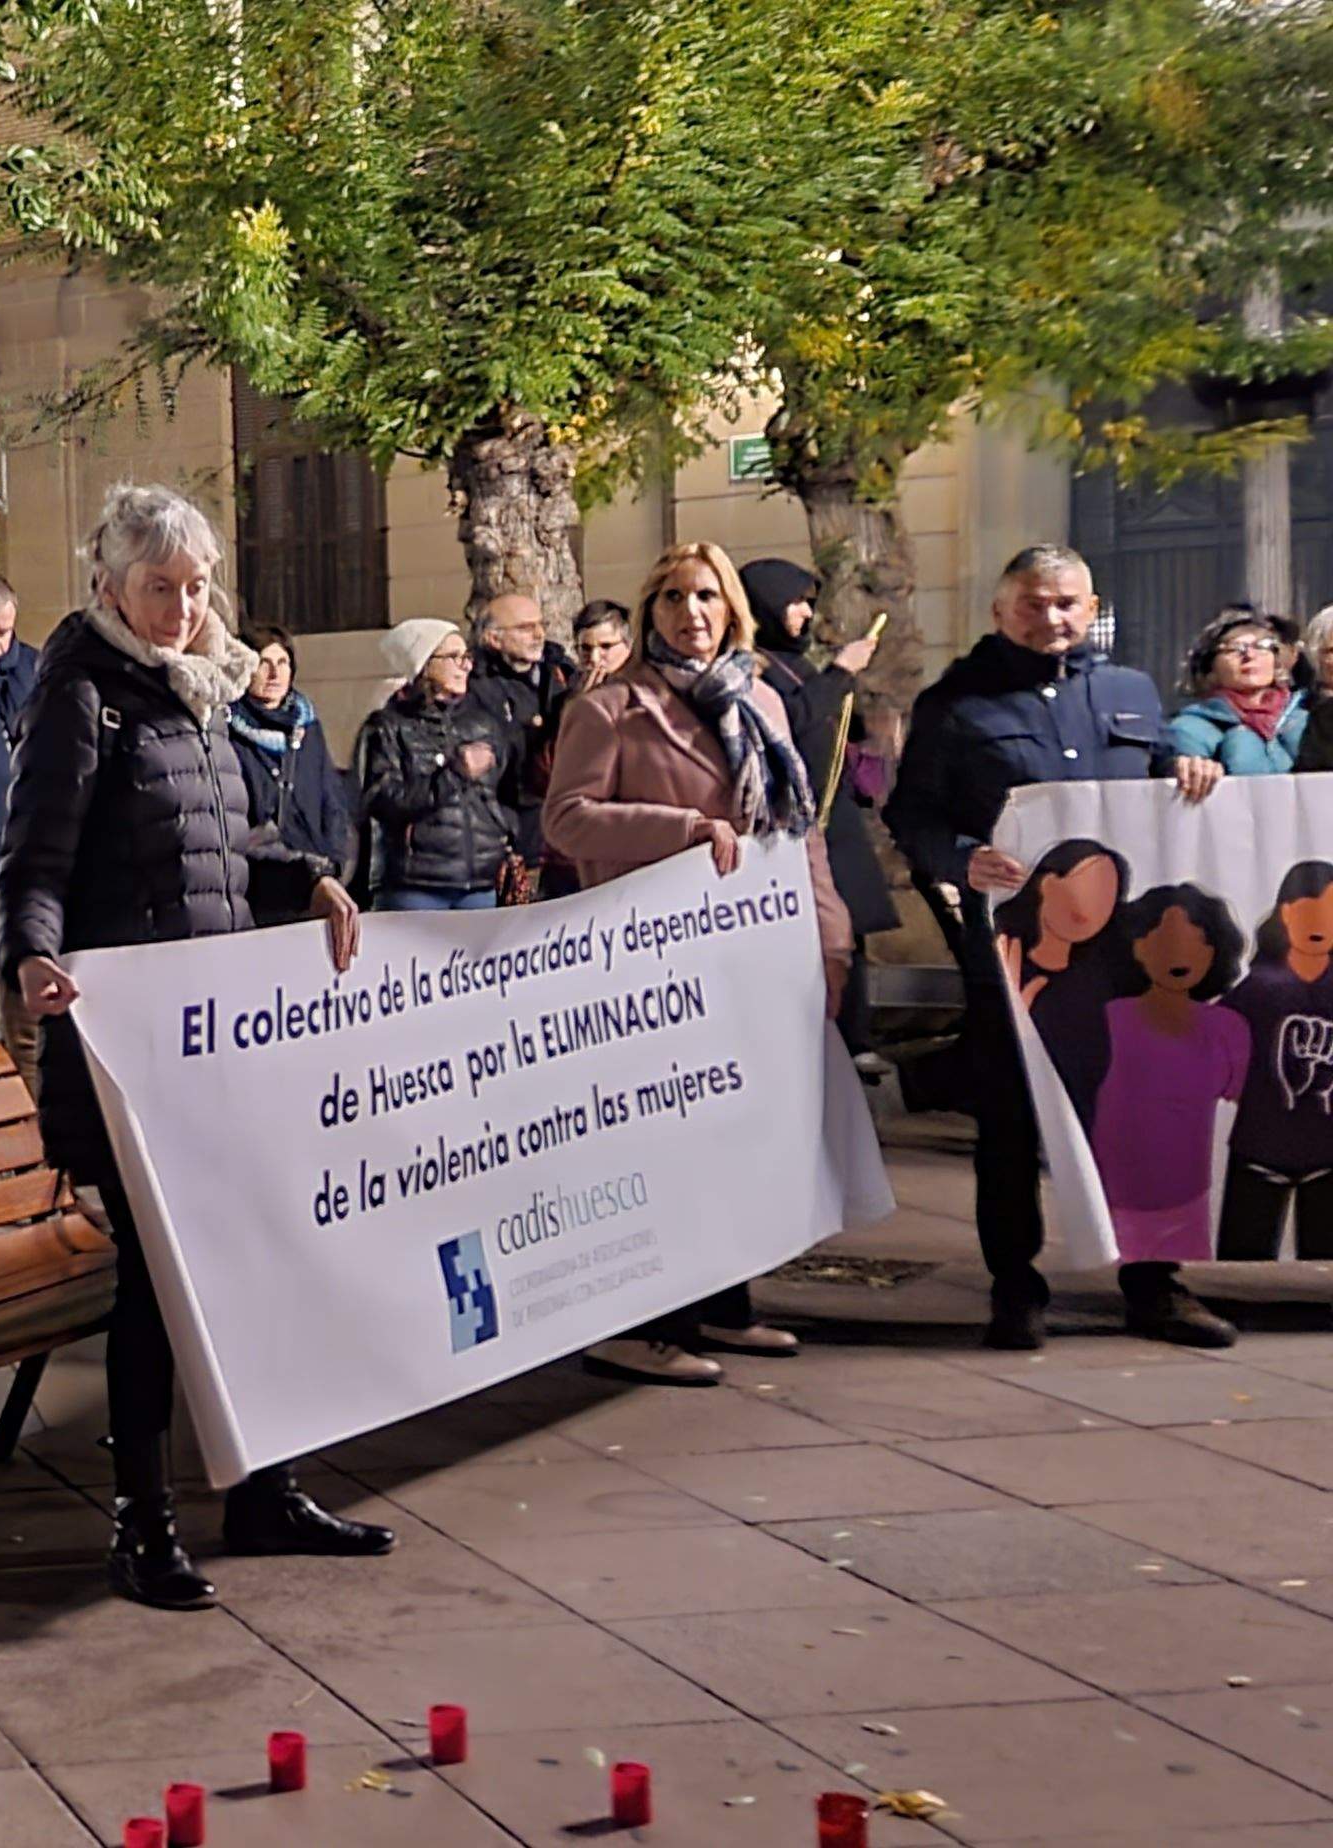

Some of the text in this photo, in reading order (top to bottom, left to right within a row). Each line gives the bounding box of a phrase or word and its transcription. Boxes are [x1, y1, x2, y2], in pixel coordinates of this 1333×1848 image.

[182, 879, 799, 1057] El colectivo de la discapacidad y dependencia
[320, 968, 706, 1128] de Huesca por la ELIMINACIÓN
[314, 1061, 742, 1226] de la violencia contra las mujeres
[498, 1172, 649, 1256] cadishuesca
